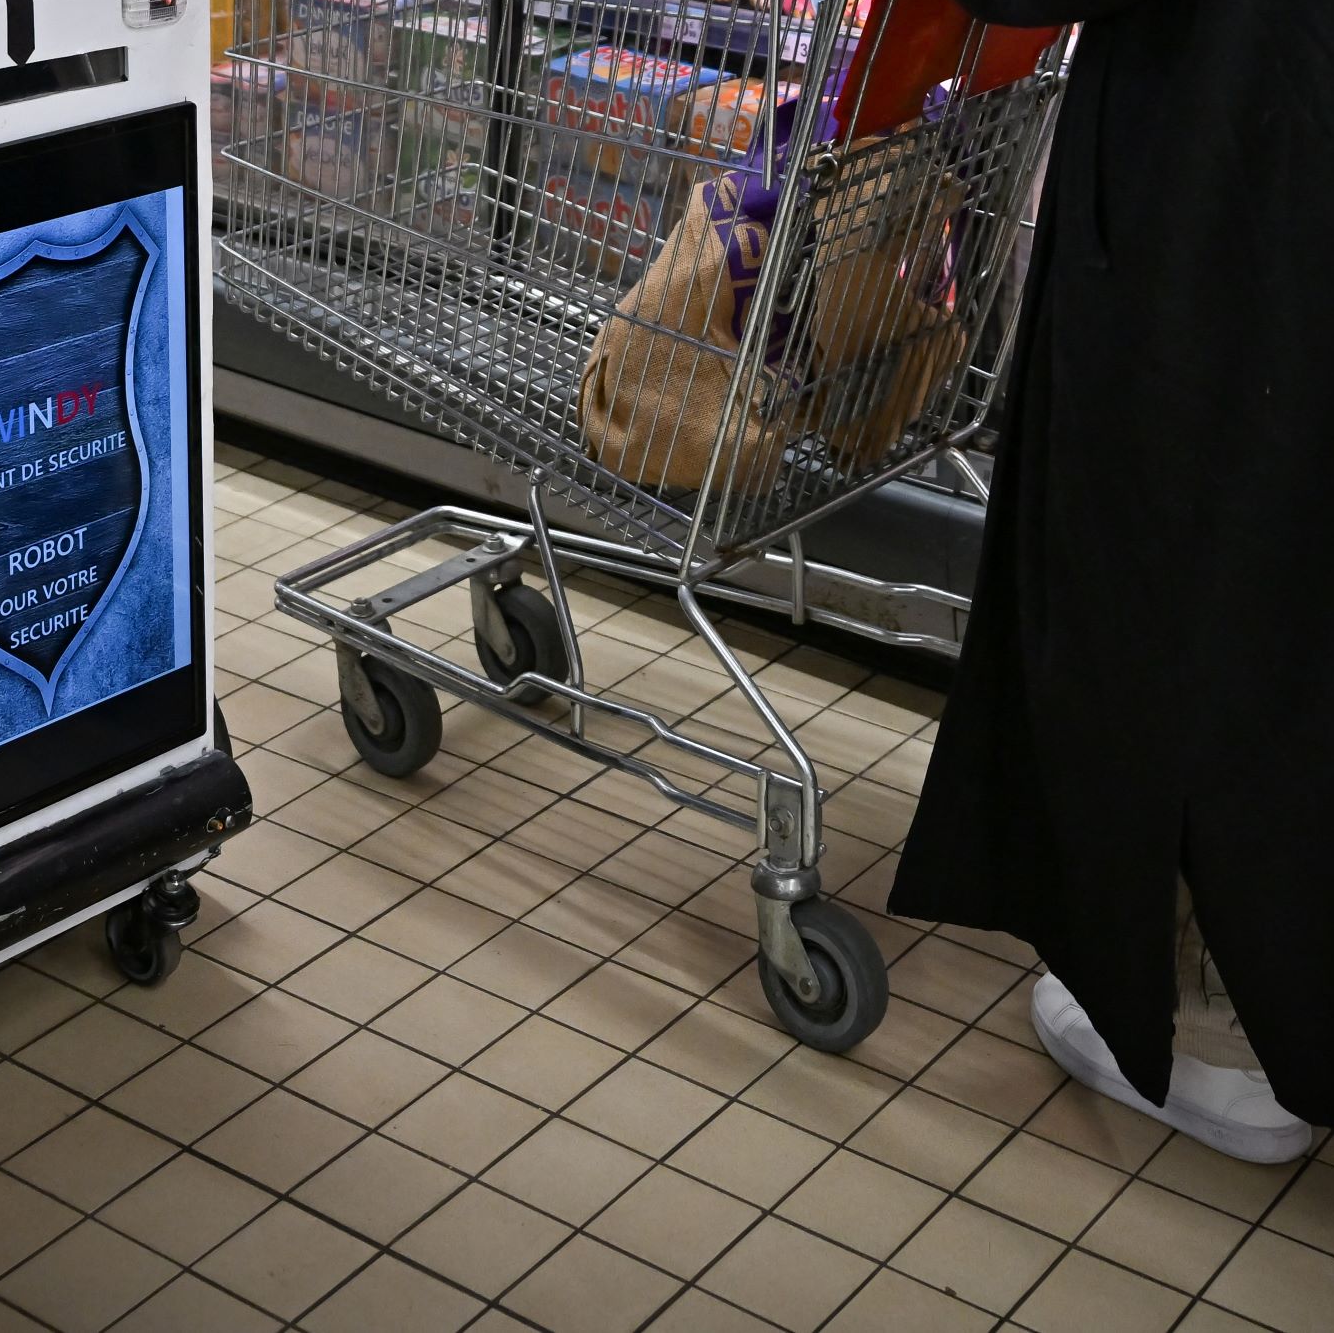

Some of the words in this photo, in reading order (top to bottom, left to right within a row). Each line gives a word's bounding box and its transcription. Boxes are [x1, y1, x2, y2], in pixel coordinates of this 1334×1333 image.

[21, 459, 43, 481] DE
[48, 431, 127, 473] SECURITE
[8, 527, 88, 576] ROBOT
[43, 566, 98, 602] VOTRE
[10, 604, 89, 649] SECURITE
